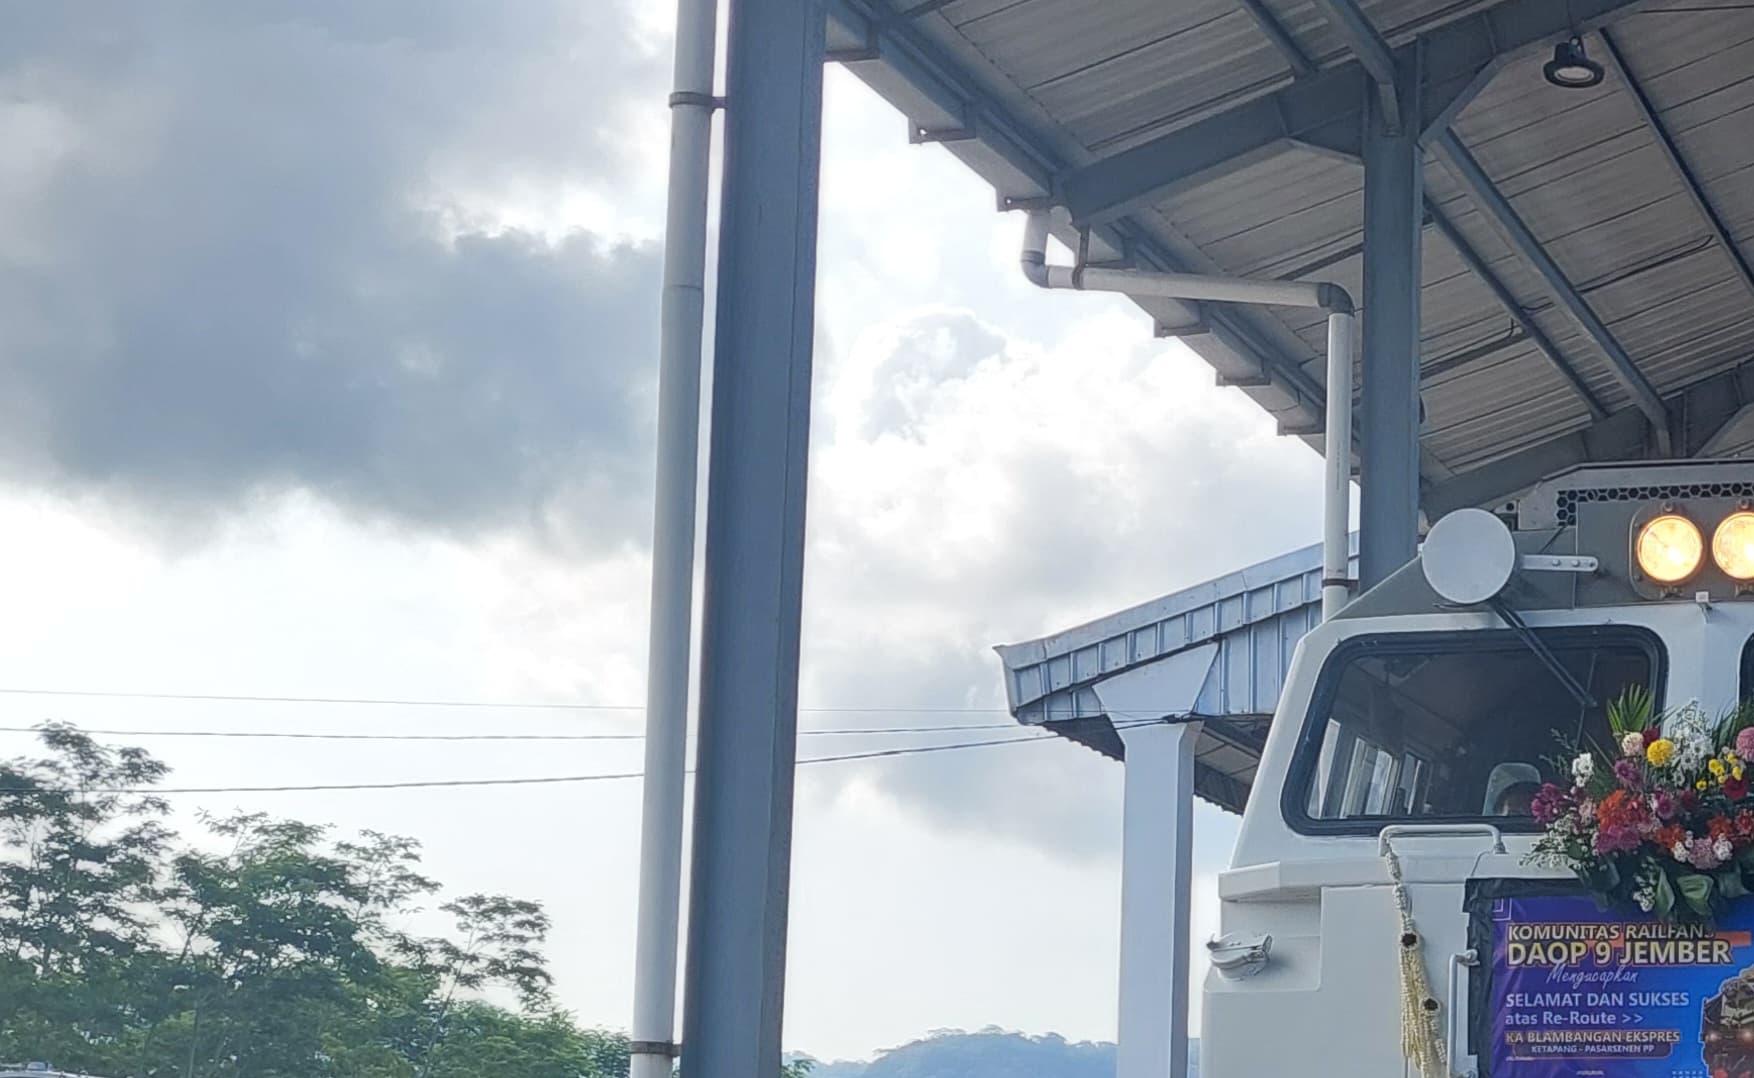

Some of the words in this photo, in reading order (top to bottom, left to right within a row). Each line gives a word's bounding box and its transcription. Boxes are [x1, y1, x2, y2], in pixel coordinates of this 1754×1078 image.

[1508, 925, 1619, 941] KOMUNITAS
[1508, 942, 1587, 965] DAOP
[1595, 942, 1610, 964] 9
[1620, 941, 1732, 964] JEMBER
[1505, 993, 1582, 1007] SELAMAT
[1587, 993, 1624, 1006] DAN
[1629, 992, 1690, 1006] SUKSES
[1505, 1012, 1538, 1024] atas
[1543, 1011, 1616, 1024] Re-Route
[1506, 1032, 1524, 1043] KA
[1527, 1032, 1622, 1043] BLAMBANGAN
[1626, 1031, 1681, 1042] EKSPRES
[1531, 1045, 1577, 1053] KETAPANG
